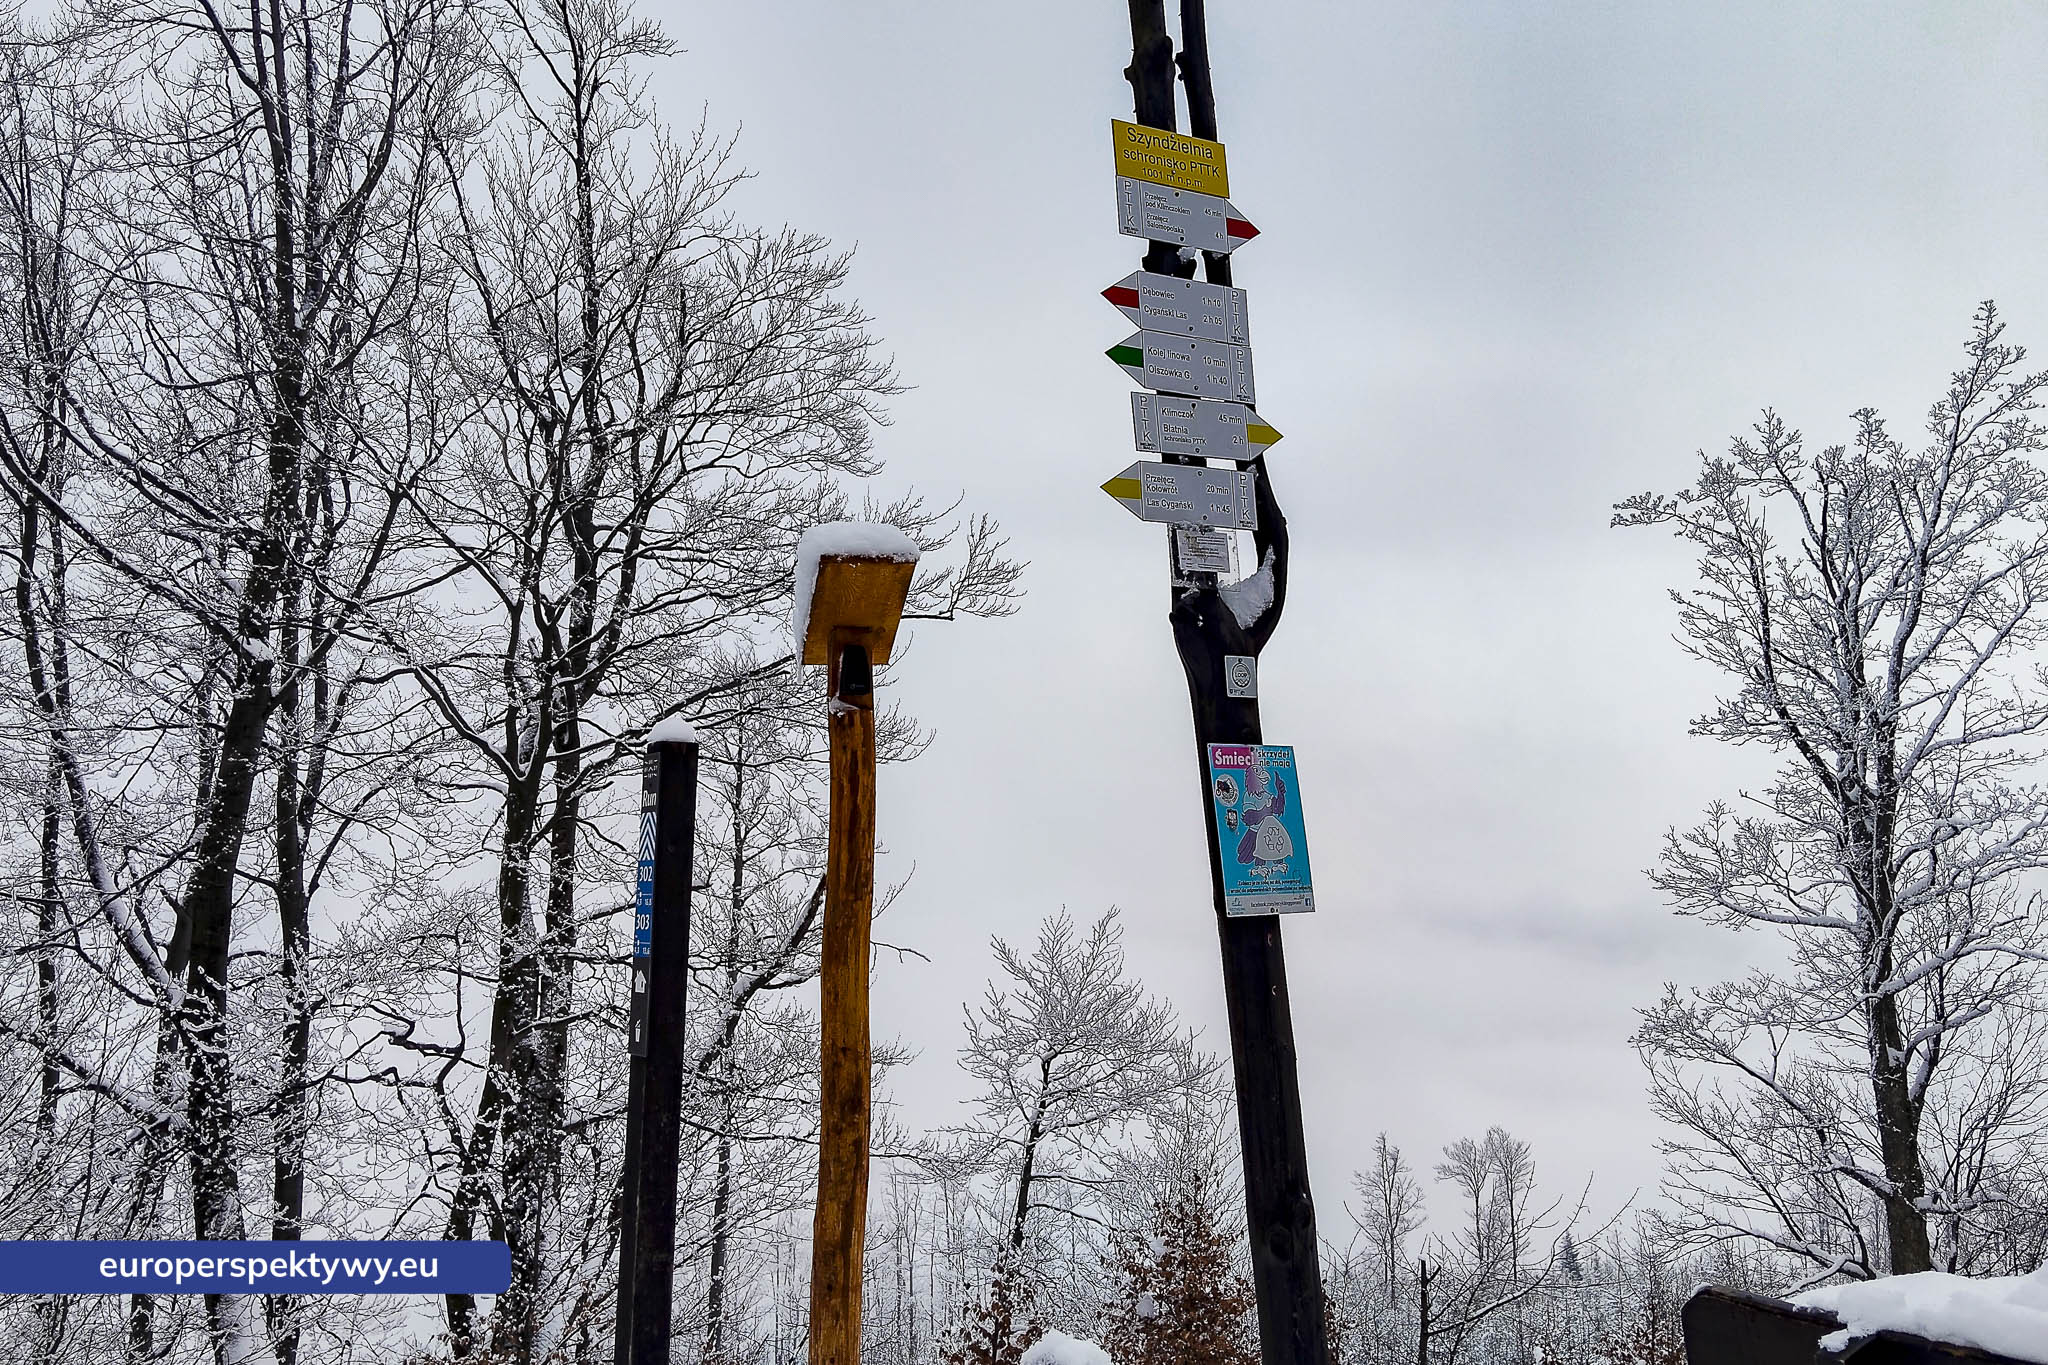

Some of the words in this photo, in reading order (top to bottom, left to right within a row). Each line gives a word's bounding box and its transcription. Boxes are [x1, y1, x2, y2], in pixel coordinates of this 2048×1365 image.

[1127, 127, 1214, 160] Szyndzielnia
[1123, 149, 1187, 171] schronisko
[1190, 161, 1220, 178] PTTK
[1142, 168, 1163, 179] 1001
[1166, 173, 1176, 181] m
[1178, 176, 1205, 188] n.p.m.
[1204, 208, 1211, 216] 45
[1142, 287, 1175, 300] Dębowiec
[1202, 297, 1206, 305] 1
[1212, 299, 1221, 307] 10
[1144, 305, 1175, 318] Cygański
[1175, 310, 1188, 319] Las
[1203, 315, 1207, 323] 2
[1214, 317, 1222, 325] 05
[1147, 346, 1166, 360] Kolej
[1167, 349, 1191, 361] linowa
[1203, 356, 1212, 365] 10
[1213, 358, 1226, 368] min
[1149, 365, 1183, 378] Olszówka
[1184, 372, 1192, 380] G.
[1207, 375, 1211, 383] 1
[1218, 376, 1227, 385] 40
[1161, 407, 1195, 419] Klimczok
[1218, 414, 1228, 423] 45
[1229, 415, 1242, 424] min
[1233, 436, 1238, 444] 2
[1238, 437, 1244, 445] h
[1145, 474, 1175, 485] Przełęcz
[1207, 485, 1215, 493] 20
[1216, 486, 1229, 495] min
[1147, 499, 1160, 507] Las
[1161, 500, 1194, 510] Cygański
[1210, 504, 1214, 512] 1
[1221, 505, 1230, 513] 45
[1215, 748, 1255, 766] Śmieci
[1257, 749, 1290, 759] skrzydeł
[1259, 758, 1271, 767] nie
[1272, 759, 1290, 769] mają
[639, 866, 653, 882] 302
[636, 914, 650, 930] 303
